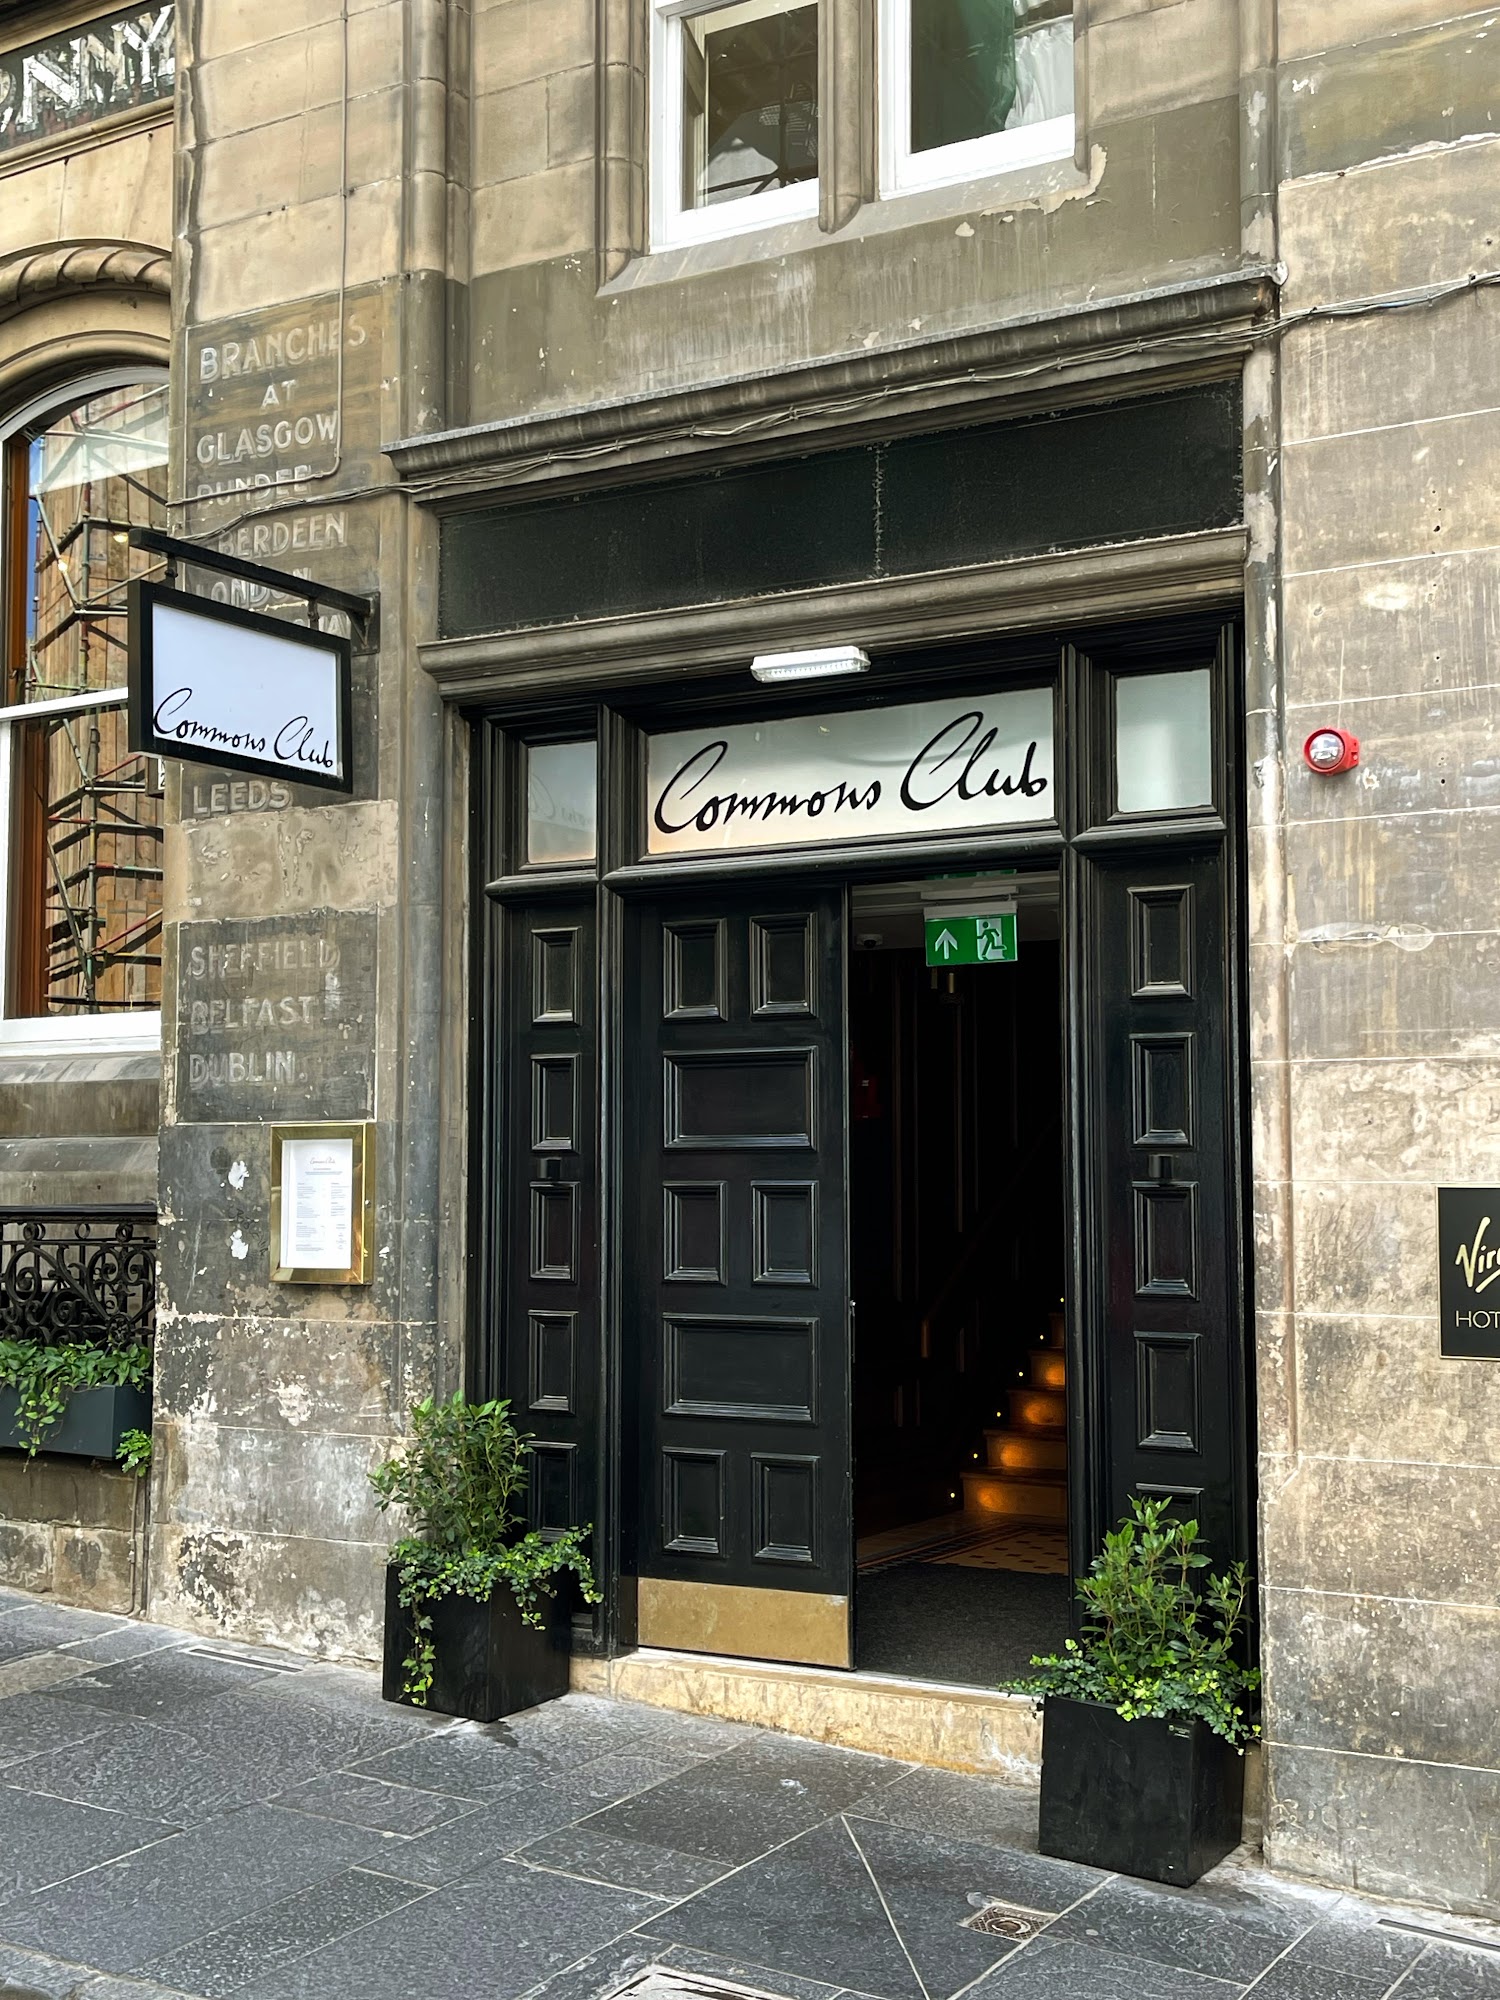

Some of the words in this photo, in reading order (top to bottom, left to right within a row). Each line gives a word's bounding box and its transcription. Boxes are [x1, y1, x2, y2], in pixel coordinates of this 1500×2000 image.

[200, 314, 367, 384] BRANCHES
[262, 379, 296, 409] AT
[197, 411, 339, 465] GLASGOW
[217, 511, 349, 560] BERDEEN
[153, 688, 266, 752] Commons
[274, 716, 333, 768] Club
[654, 740, 882, 834] Commons
[900, 711, 1049, 811] Club
[193, 781, 293, 818] LEEDS
[188, 939, 341, 980] SHEFFIELD
[190, 996, 318, 1036] BELFAST
